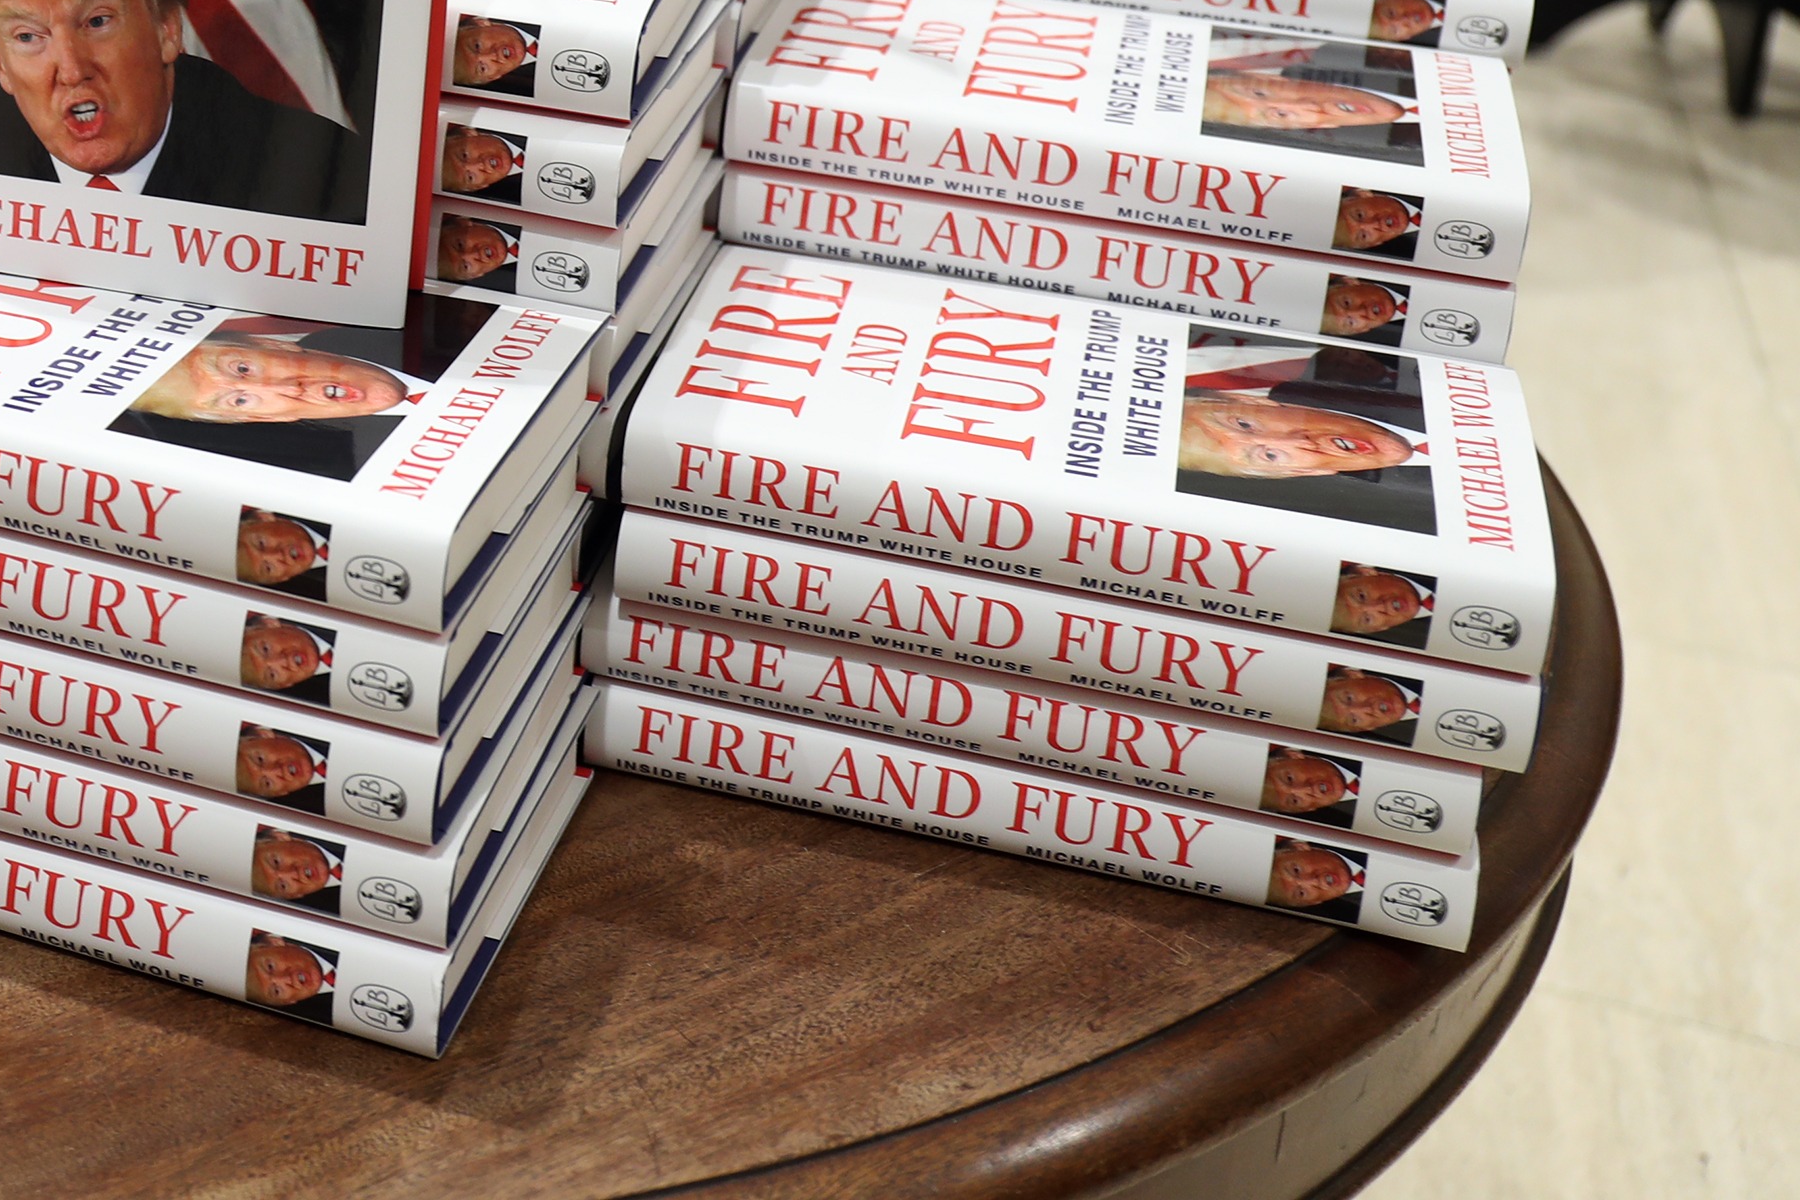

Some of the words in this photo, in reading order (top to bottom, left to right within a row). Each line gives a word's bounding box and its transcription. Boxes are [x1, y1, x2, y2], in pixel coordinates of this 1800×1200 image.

[907, 20, 966, 62] AND
[1124, 12, 1153, 50] TRUMP
[1163, 30, 1194, 69] HOUSE
[1116, 52, 1146, 76] THE
[1154, 70, 1188, 113] WHITE
[1435, 52, 1478, 101] WOLFF
[1104, 79, 1141, 125] INSIDE
[765, 100, 911, 163] FIRE
[930, 128, 1079, 186] AND
[1102, 150, 1285, 218] FURY
[1441, 102, 1491, 179] MICHAEL
[747, 150, 813, 168] INSIDE
[821, 161, 858, 175] THE
[868, 168, 935, 186] TRUMP
[944, 179, 1008, 198] WHITE
[1016, 191, 1086, 210] HOUSE
[1117, 208, 1210, 230] MICHAEL
[1221, 224, 1293, 242] WOLFF
[173, 224, 365, 287] WOLFF
[2, 346, 102, 413] INSIDE
[83, 307, 149, 341] THE
[676, 266, 854, 417] FIRE
[841, 323, 908, 386] AND
[1085, 309, 1122, 362] TRUMP
[1132, 334, 1168, 394] HOUSE
[81, 337, 173, 397] WHITE
[900, 288, 1060, 461] FURY
[1078, 367, 1114, 401] THE
[1444, 362, 1495, 432] WOLFF
[380, 378, 502, 499] MICHAEL
[472, 310, 561, 395] WOLFF
[1123, 397, 1162, 457] WHITE
[1064, 408, 1109, 478] INSIDE
[673, 442, 840, 519] FIRE
[861, 480, 1034, 552] AND
[1060, 512, 1276, 596] FURY
[1456, 434, 1515, 551] MICHAEL
[4, 516, 106, 550] MICHAEL
[115, 543, 194, 569] WOLFF
[655, 496, 738, 520] INSIDE
[738, 512, 782, 530] THE
[791, 522, 869, 545] TRUMP
[880, 539, 952, 562] WHITE
[963, 555, 1043, 578] HOUSE
[1080, 577, 1189, 606] MICHAEL
[1200, 599, 1285, 622] WOLFF
[634, 706, 796, 784] FIRE
[816, 747, 982, 819] AND
[1007, 782, 1213, 868] FURY
[0, 859, 193, 959] FURY
